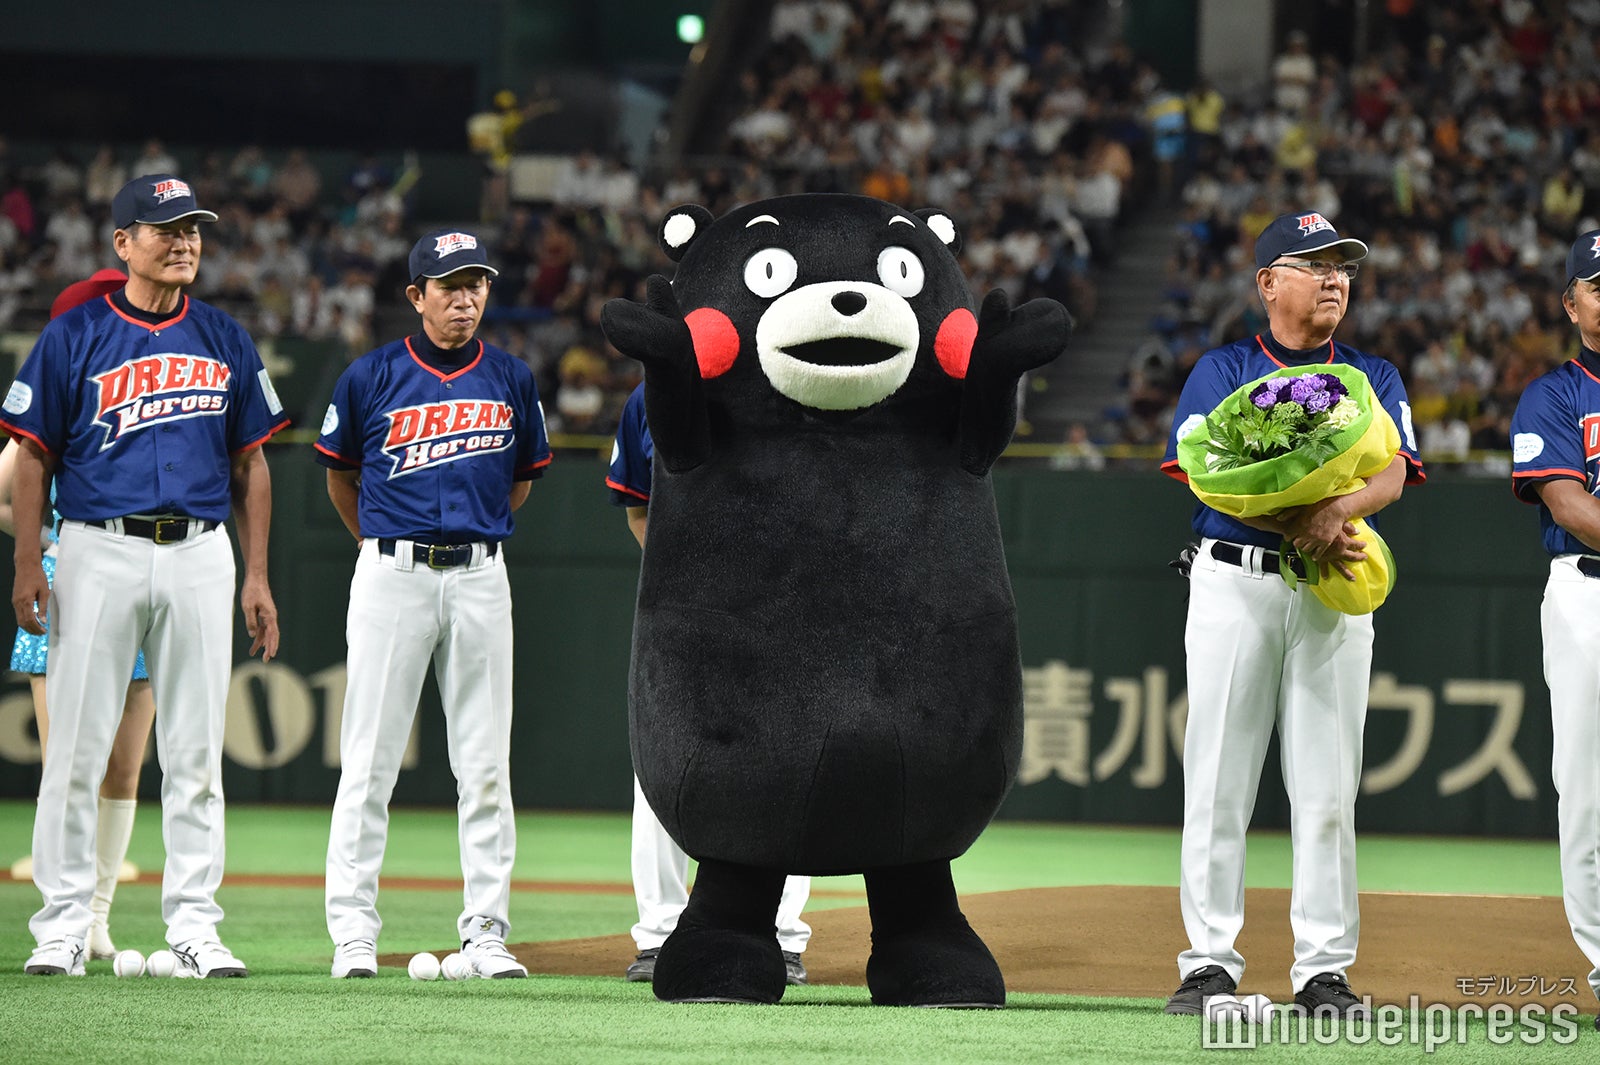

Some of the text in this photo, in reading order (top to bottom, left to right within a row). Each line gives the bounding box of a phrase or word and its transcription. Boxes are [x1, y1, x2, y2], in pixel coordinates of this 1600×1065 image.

[96, 356, 231, 419] DREAM
[115, 394, 223, 439] Heroes
[385, 402, 513, 447] DREAM
[401, 434, 504, 470] Heroes
[1020, 661, 1537, 798] 積水ウス
